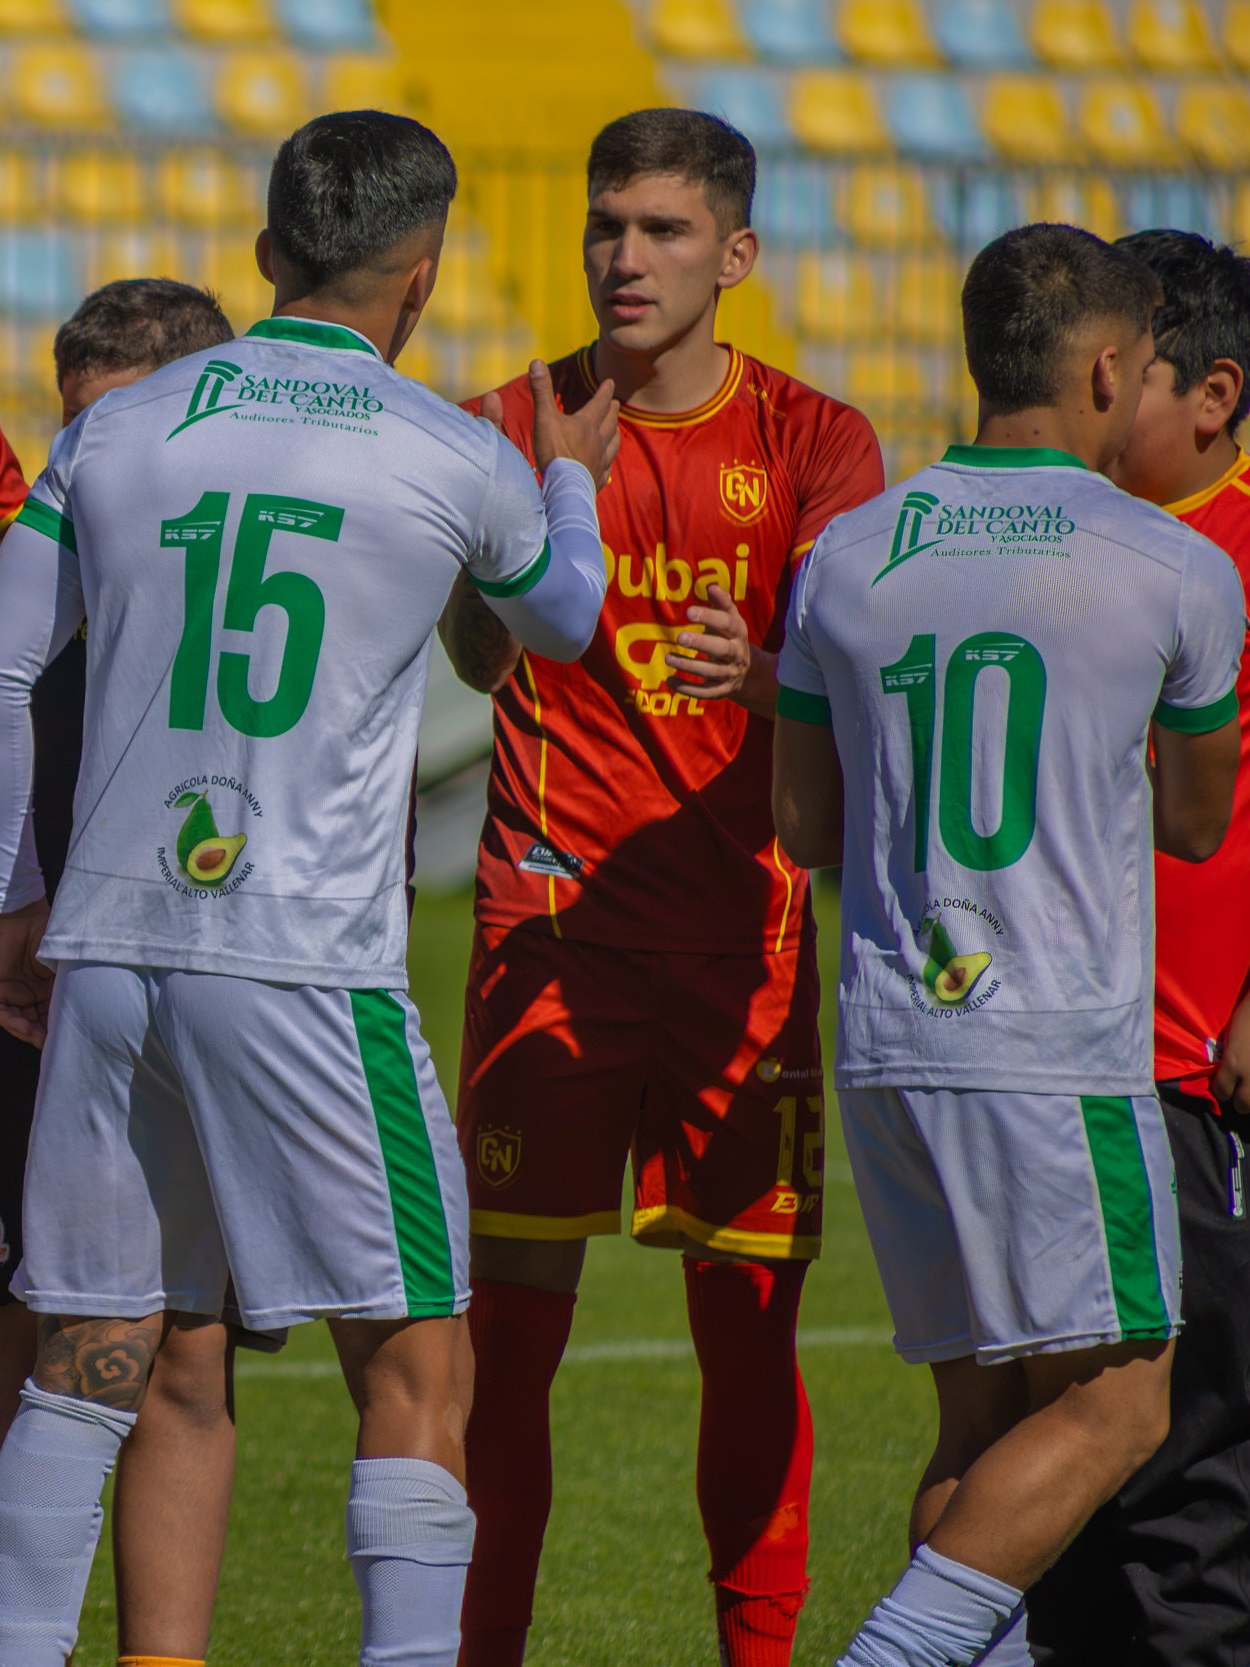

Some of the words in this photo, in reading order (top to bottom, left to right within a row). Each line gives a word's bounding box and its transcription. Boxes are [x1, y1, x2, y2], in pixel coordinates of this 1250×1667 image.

[240, 374, 375, 399] SANDOVAL
[237, 387, 283, 405] DEL
[289, 393, 384, 413] CANTO
[229, 411, 295, 425] Auditores
[300, 416, 379, 437] Tributarios
[303, 406, 370, 421] ASOCIADOS
[938, 504, 1068, 521] SANDOVAL
[936, 519, 979, 535] DEL
[985, 519, 1075, 536] CANTO
[1000, 535, 1063, 544] ASOCIADOS
[931, 547, 991, 558] Auditores
[997, 547, 1071, 559] Tributarios
[160, 491, 345, 738] 15
[879, 631, 1047, 874] 10
[164, 775, 208, 809] AGRICOLA
[211, 775, 243, 793] DOÑA
[242, 789, 263, 818] ANNY
[157, 846, 181, 892] IMPERIAL
[181, 886, 208, 900] ALTO
[211, 861, 255, 899] VALLENAR
[943, 897, 978, 914] DOÑA
[979, 908, 1004, 936] ANNY
[926, 1007, 953, 1019] ALTO
[955, 979, 1002, 1017] VALLENAR
[773, 1096, 824, 1187] 12
